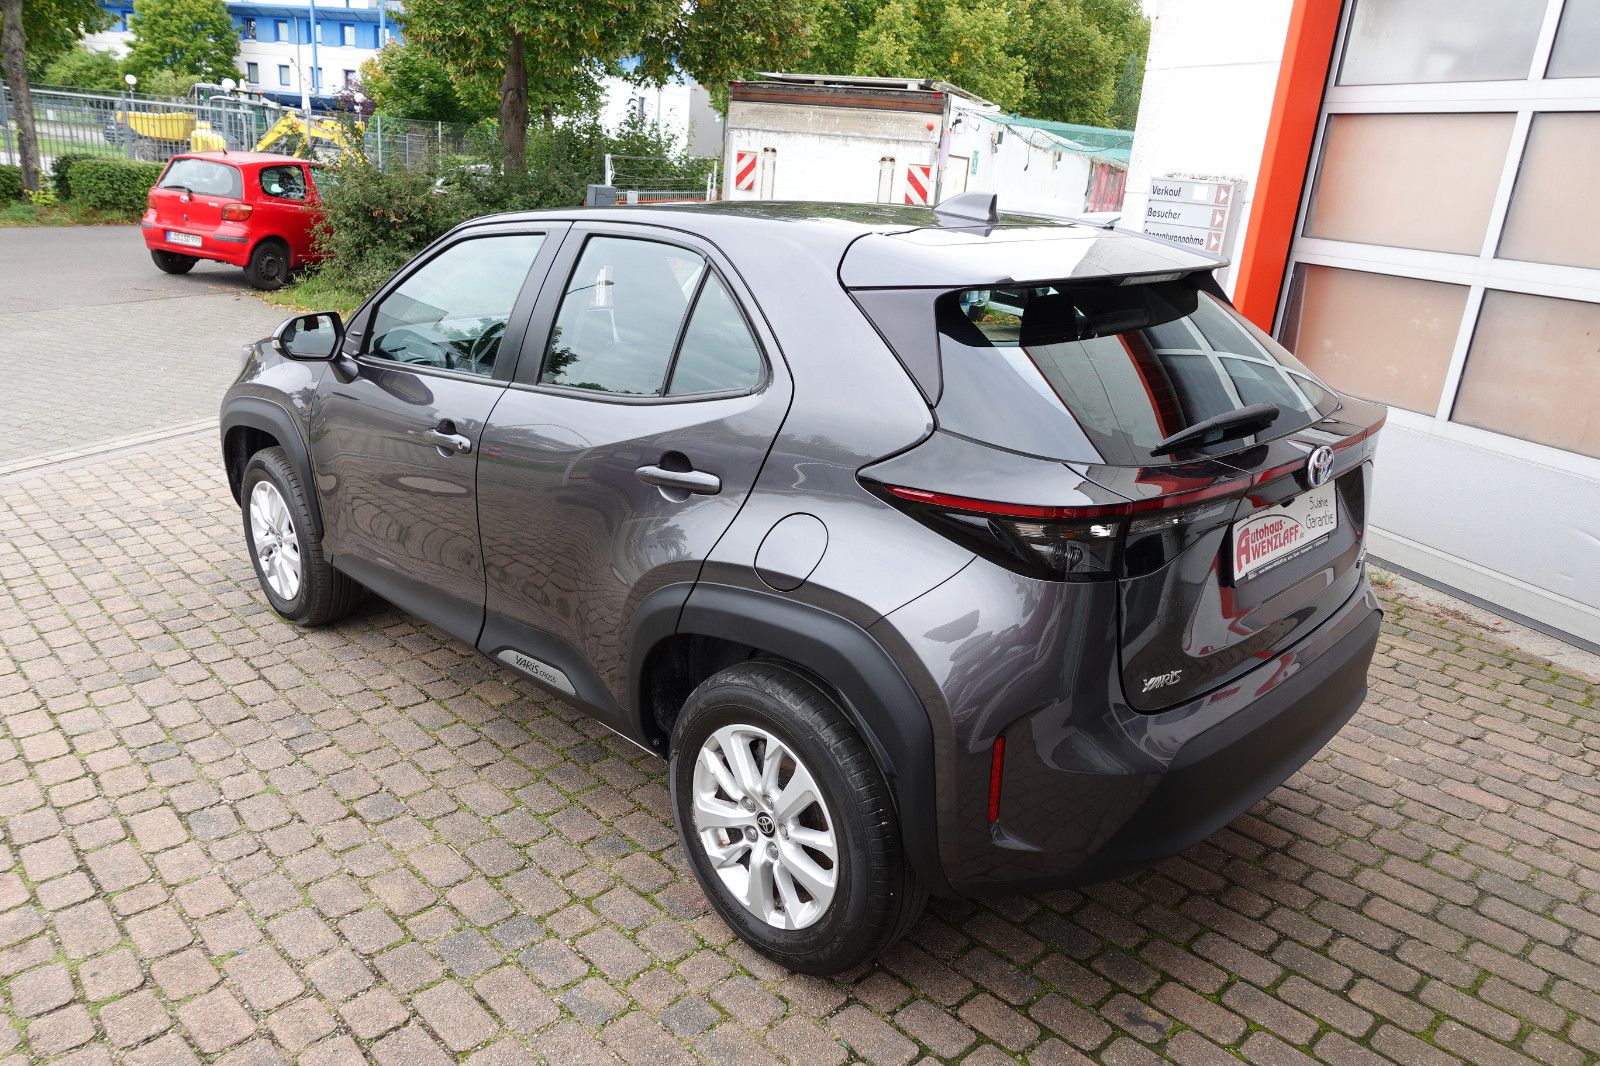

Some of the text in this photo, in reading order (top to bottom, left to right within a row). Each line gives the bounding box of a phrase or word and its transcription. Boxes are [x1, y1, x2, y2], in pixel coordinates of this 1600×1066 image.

[1152, 185, 1182, 197] Verkauf
[1147, 207, 1181, 220] Besucher
[1309, 496, 1328, 510] 5 Jahre
[1305, 510, 1334, 530] Garantie
[1252, 525, 1299, 561] WENZLAFF
[539, 670, 557, 683] CROSS
